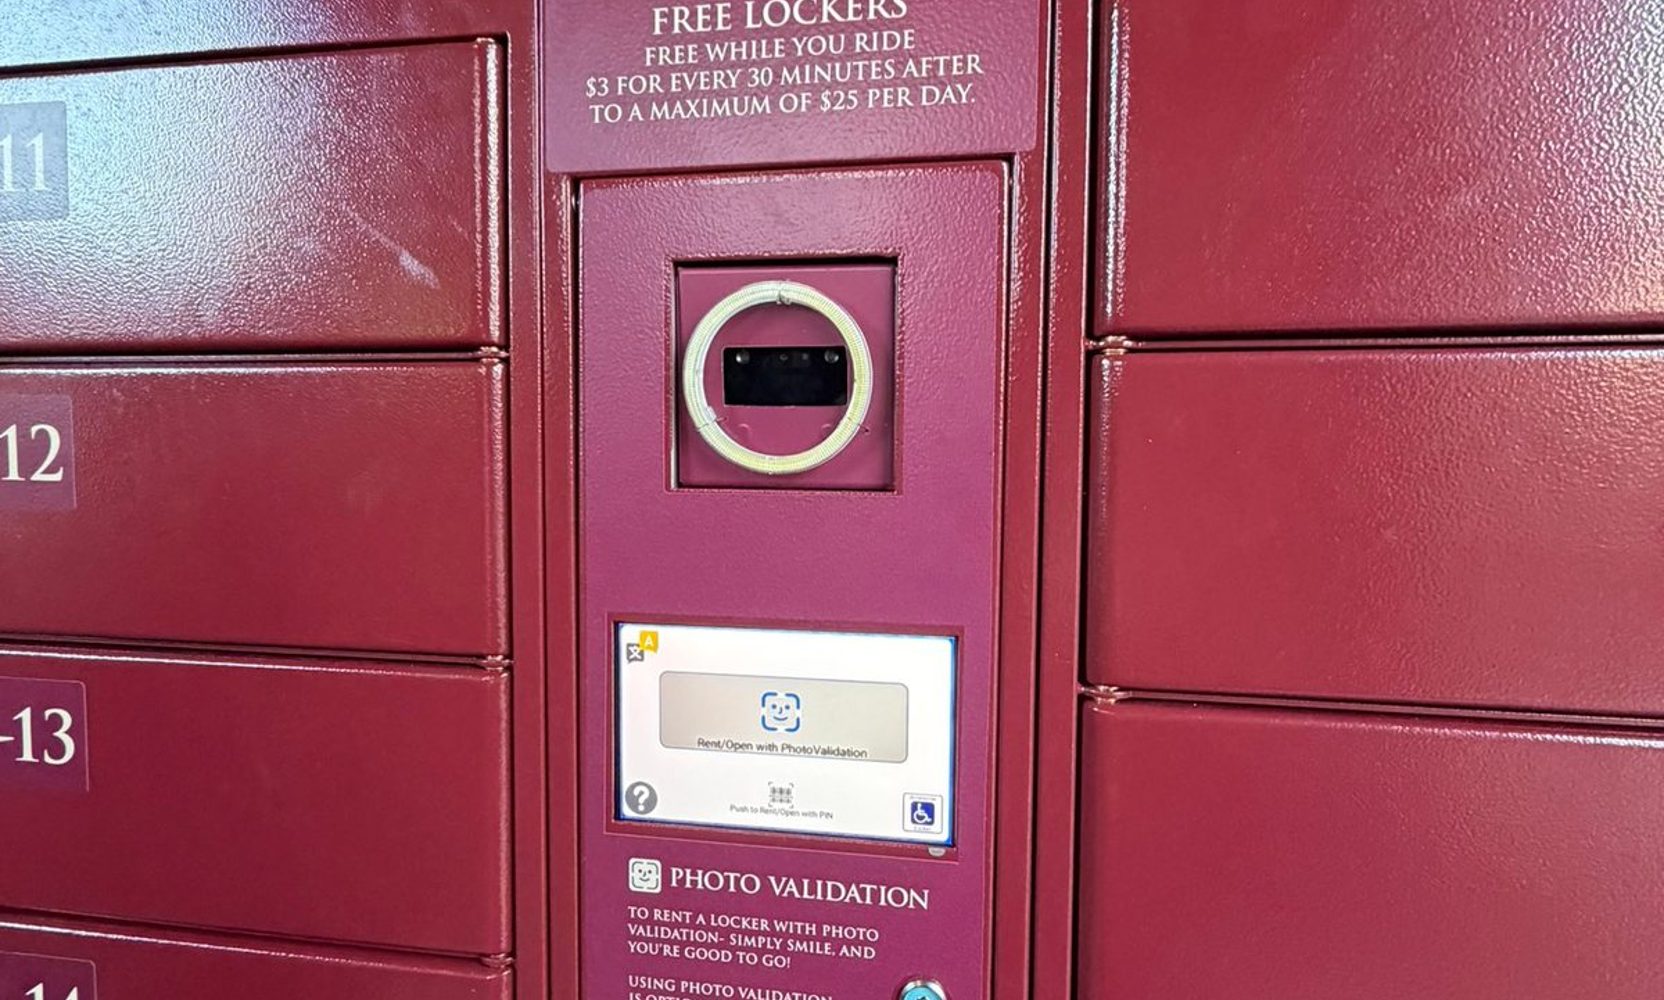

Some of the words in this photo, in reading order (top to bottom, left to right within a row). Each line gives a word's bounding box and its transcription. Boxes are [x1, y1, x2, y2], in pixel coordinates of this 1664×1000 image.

[652, 3, 732, 35] FREE
[745, 0, 907, 29] LOCKERS
[645, 44, 699, 67] FREE
[705, 38, 786, 62] WHILE
[792, 34, 845, 57] YOU
[855, 29, 916, 53] RIDE
[585, 76, 610, 98] $3
[617, 74, 664, 96] FOR
[670, 69, 742, 93] EVERY
[747, 66, 773, 88] 30
[780, 59, 895, 86] MINUTES
[902, 54, 985, 79] AFTER
[589, 103, 622, 124] TO
[628, 102, 644, 122] A
[650, 95, 771, 120] MAXIMUM
[779, 92, 812, 114] OF
[820, 89, 858, 112] $25
[867, 87, 914, 109] PER
[921, 83, 976, 106] DAY.
[0, 131, 47, 193] 11
[0, 423, 64, 482] 12
[697, 737, 754, 751] Rent/Open
[756, 741, 779, 754] with
[781, 742, 868, 760] PhotoValidation
[730, 803, 748, 814] Push
[750, 805, 758, 815] to
[759, 806, 800, 819] Rent/Open
[801, 809, 818, 819] with
[819, 810, 834, 820] PIN
[670, 867, 761, 895] PHOTO
[768, 876, 929, 910] VALIDATION
[627, 906, 649, 920] TO
[653, 908, 693, 924] RENT
[695, 913, 707, 926] A
[710, 913, 771, 932] LOCKER
[773, 919, 817, 936] WITH
[822, 924, 880, 942] PHOTO
[627, 923, 725, 944] VALIDATION-
[729, 933, 783, 951] SIMPLY
[839, 944, 876, 960] AND
[627, 941, 681, 958] YOU'RE
[684, 946, 733, 963] GOOD
[735, 951, 759, 966] TO
[762, 954, 791, 969] GO!
[628, 975, 676, 992] USING
[680, 980, 735, 998] PHOTO
